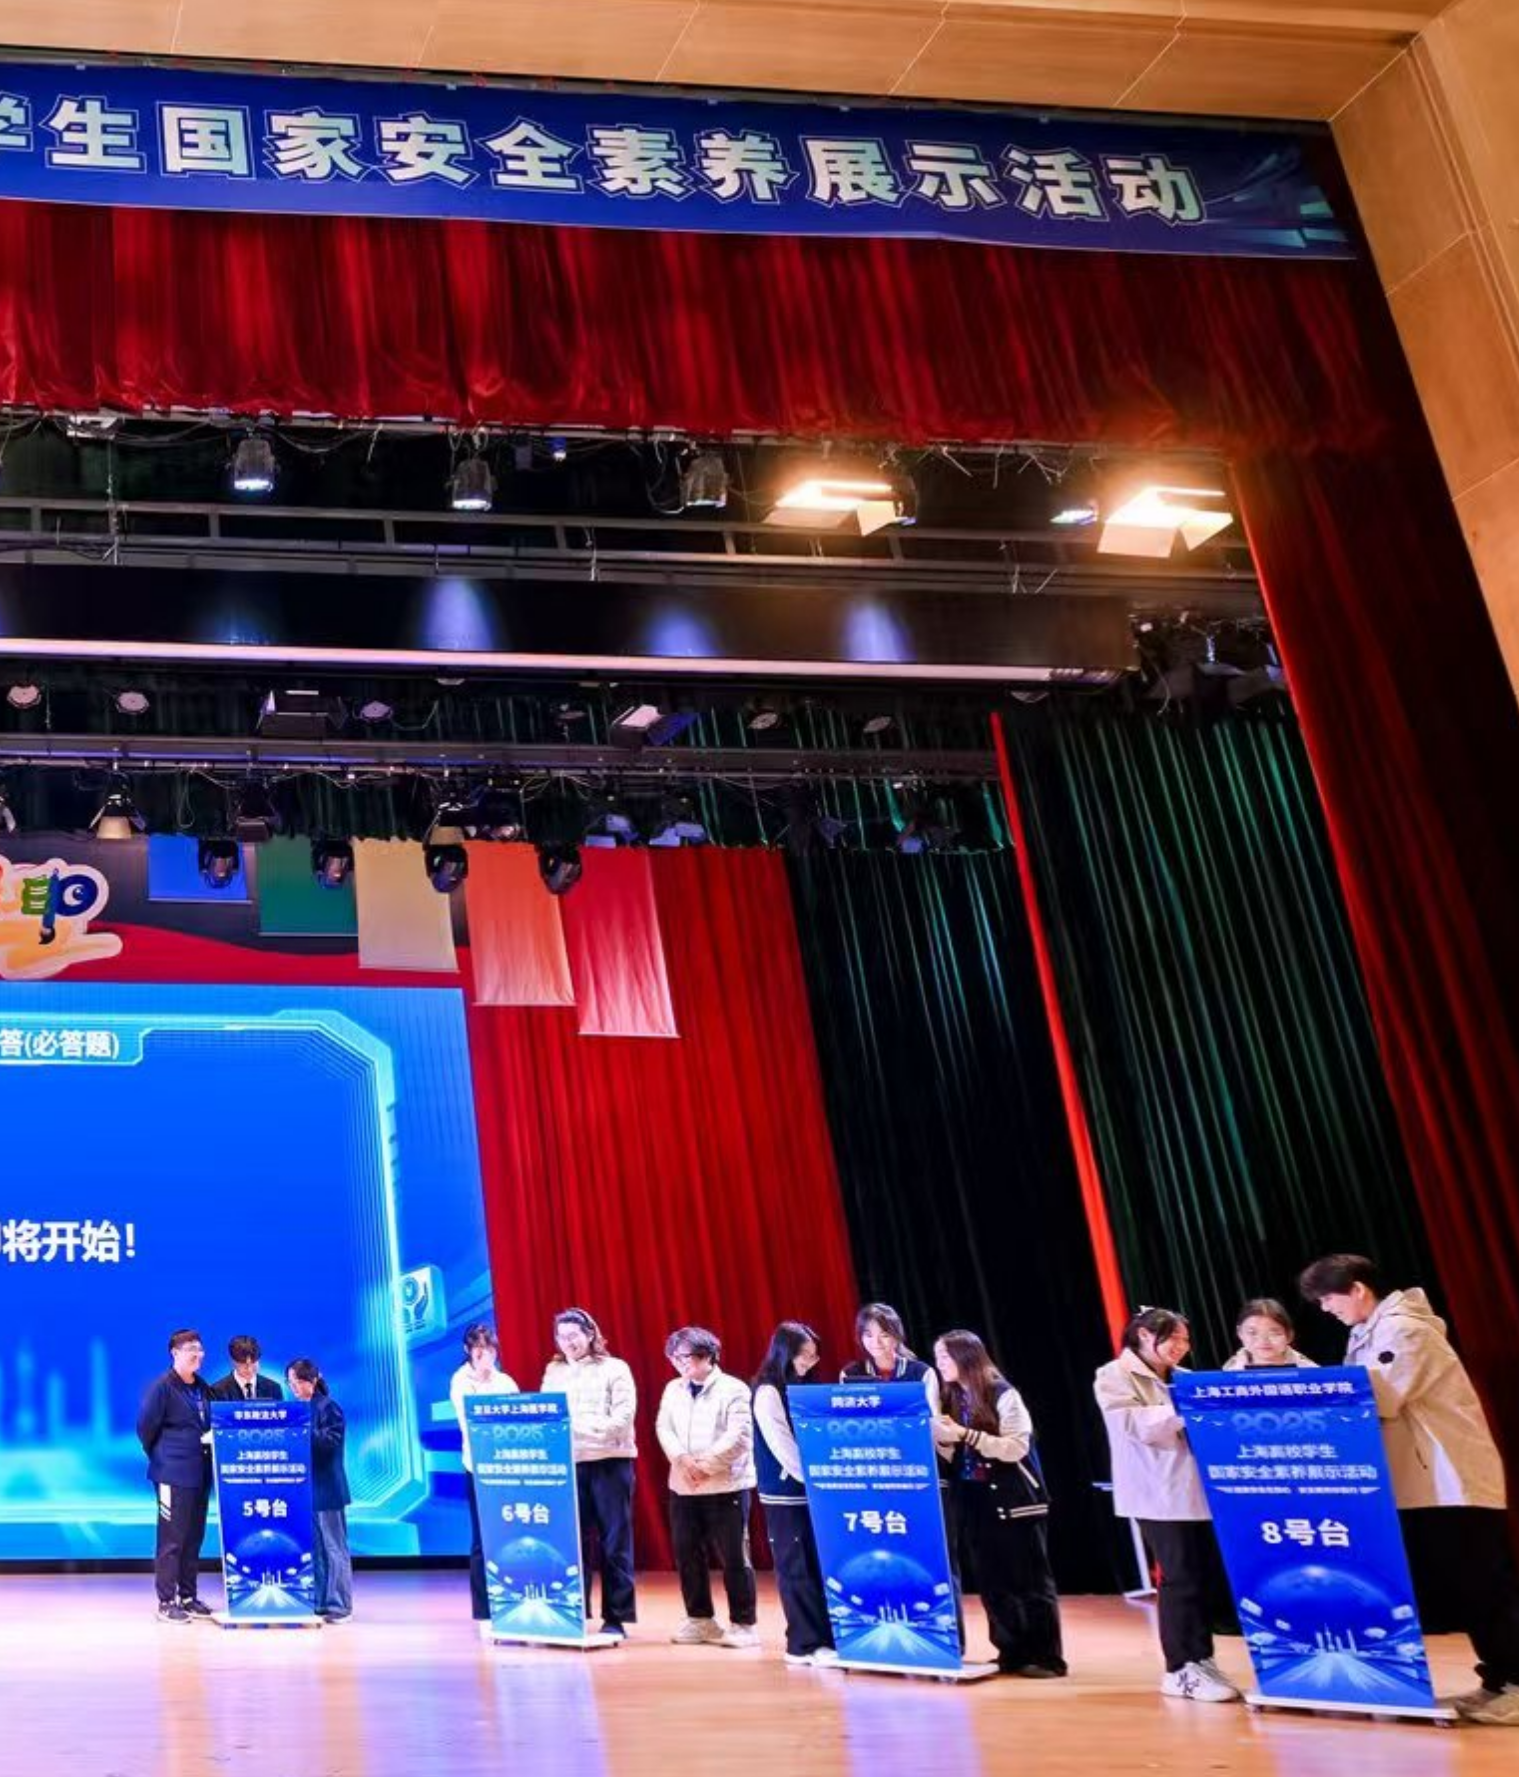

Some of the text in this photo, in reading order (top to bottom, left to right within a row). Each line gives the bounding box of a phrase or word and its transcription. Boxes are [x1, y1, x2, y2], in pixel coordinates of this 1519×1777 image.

[1231, 1411, 1327, 1435] 2025
[1237, 1444, 1339, 1459] 上海高校学生
[242, 1499, 288, 1518] 5号台
[501, 1503, 549, 1524] 6号台
[843, 1510, 908, 1535] 7号台
[1260, 1518, 1350, 1547] 8号台
